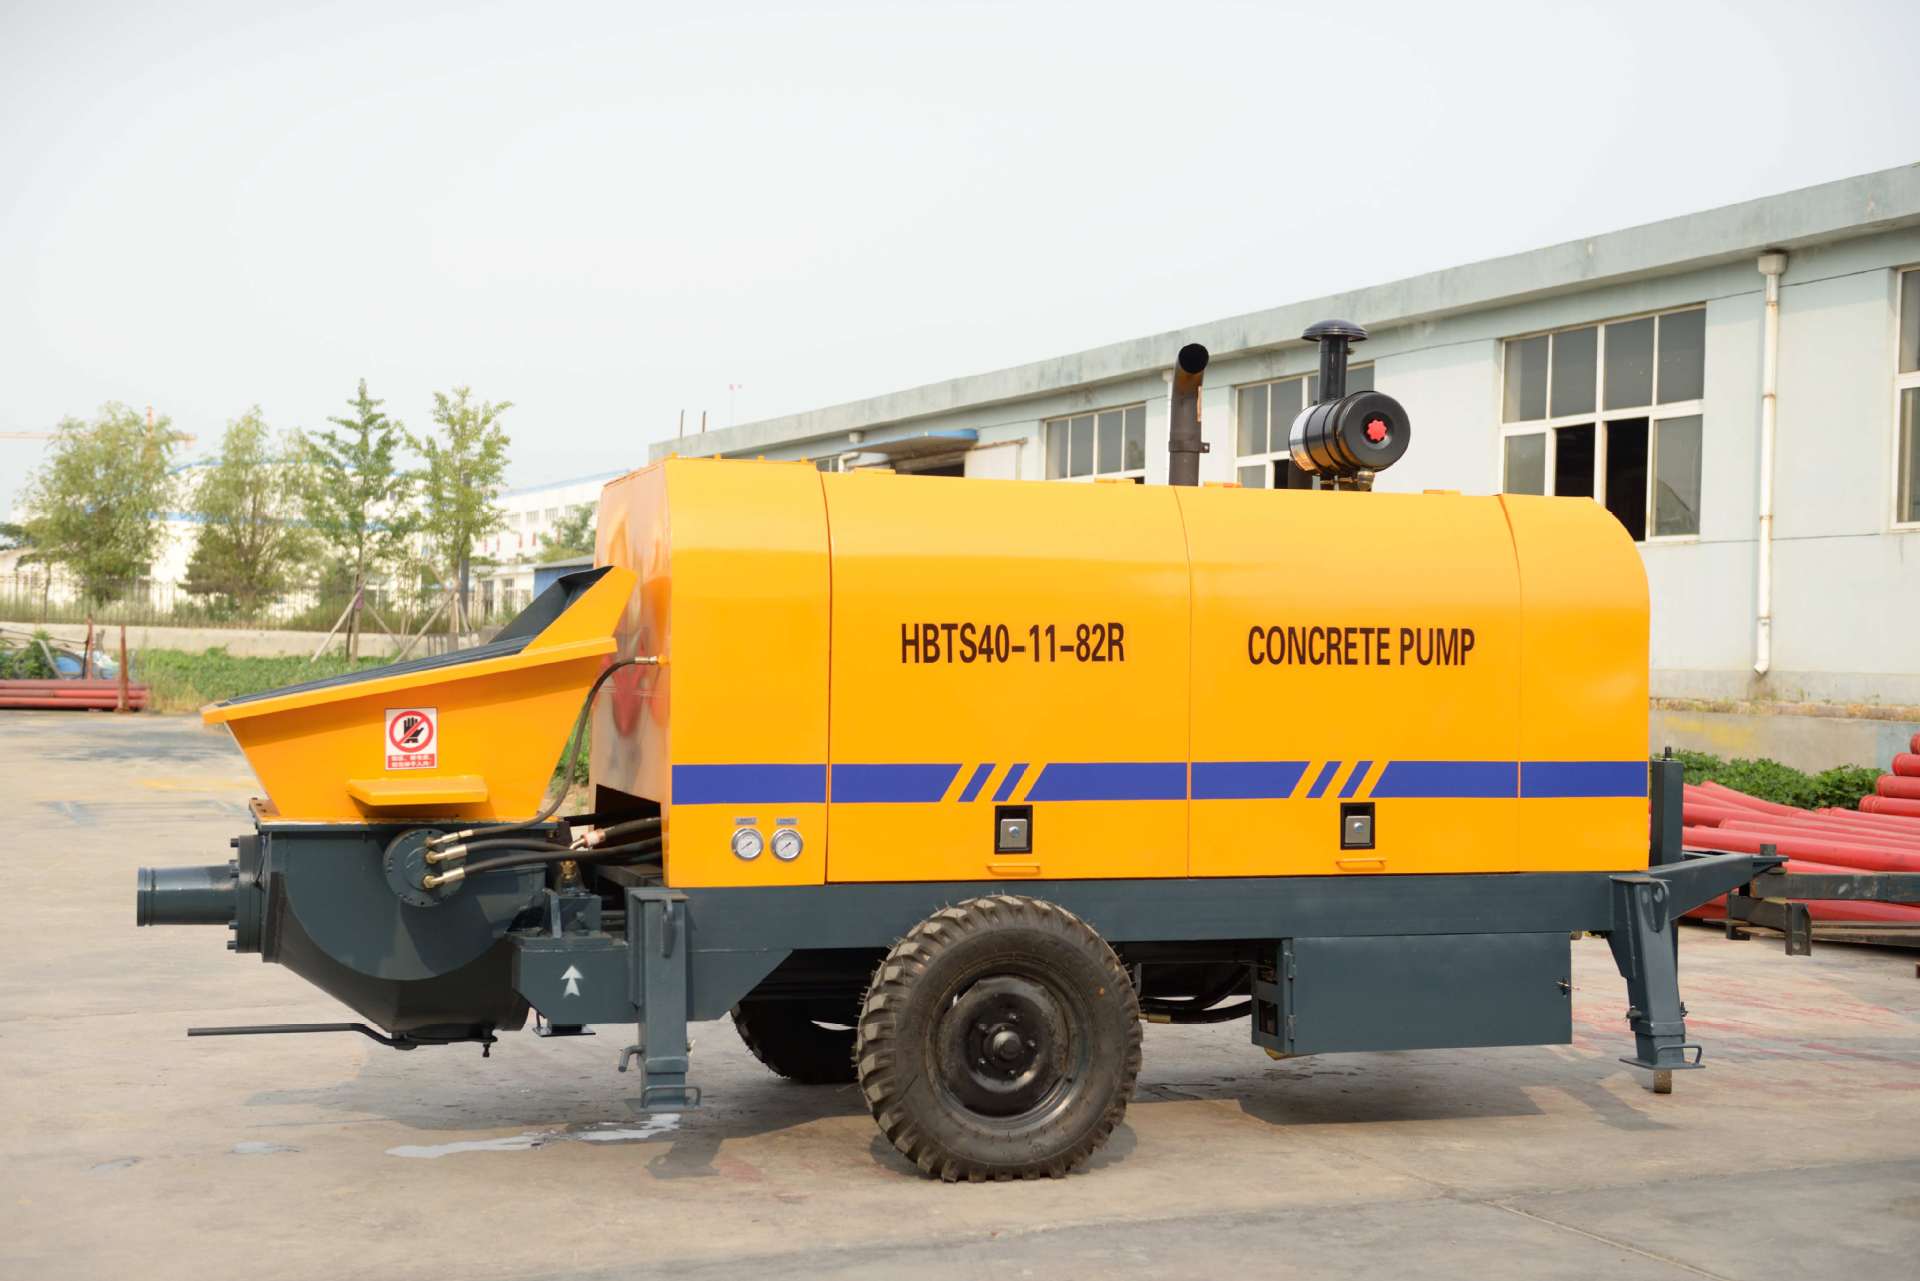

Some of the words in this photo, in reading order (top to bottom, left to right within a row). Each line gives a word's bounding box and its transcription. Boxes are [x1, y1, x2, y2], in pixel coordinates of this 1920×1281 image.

[902, 622, 1124, 664] HBTS40-11-82R
[1248, 626, 1390, 666] CONCRETE
[1400, 627, 1474, 666] PUMP
